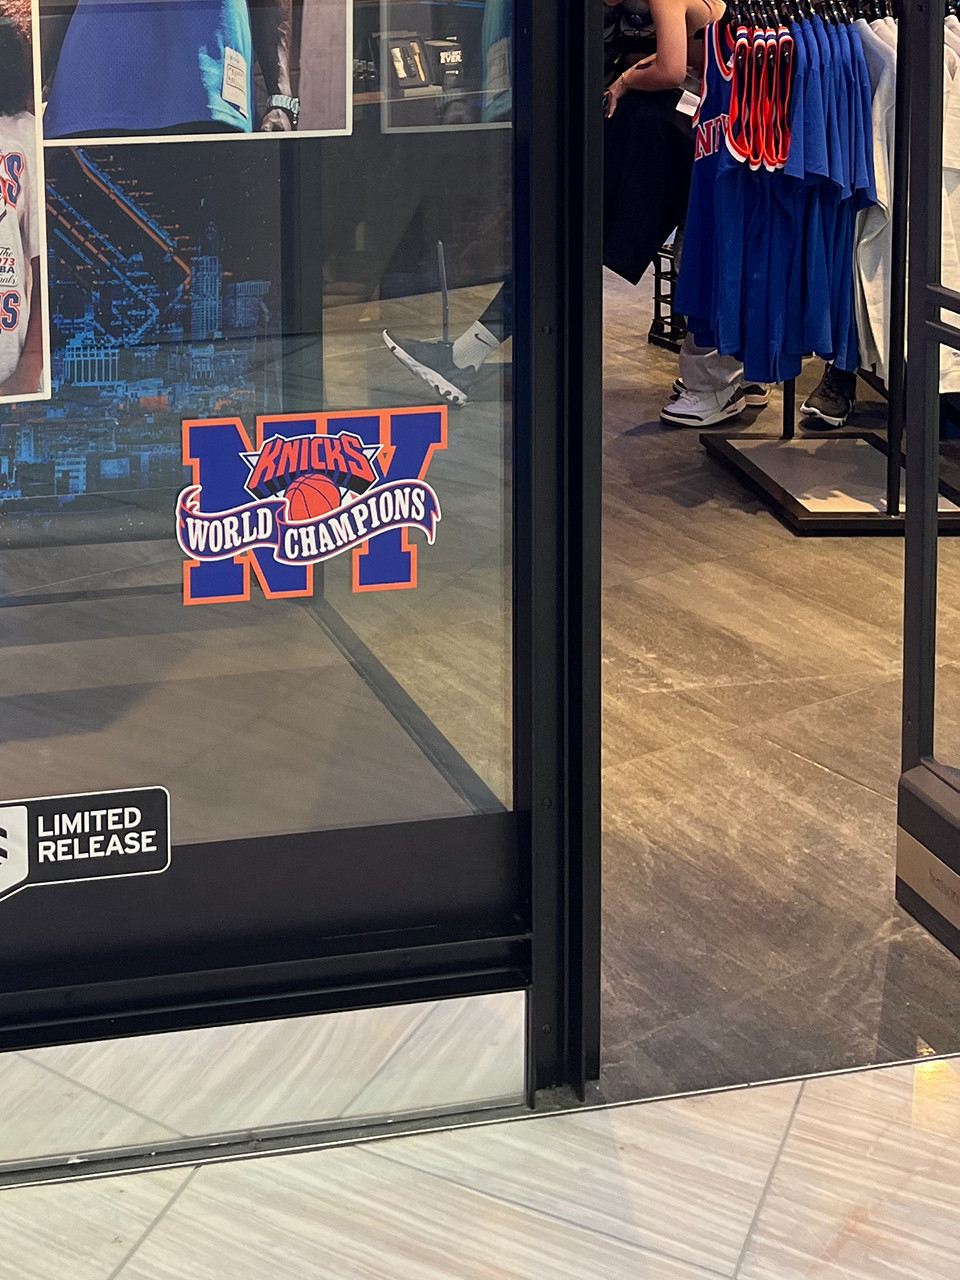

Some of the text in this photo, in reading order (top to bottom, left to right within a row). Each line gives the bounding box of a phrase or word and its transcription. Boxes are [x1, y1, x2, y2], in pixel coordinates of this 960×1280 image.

[248, 433, 376, 492] KNICKS
[186, 487, 426, 559] WORLD CHAMPIONS
[37, 806, 142, 837] LIMITED
[37, 830, 157, 863] RELEASE
